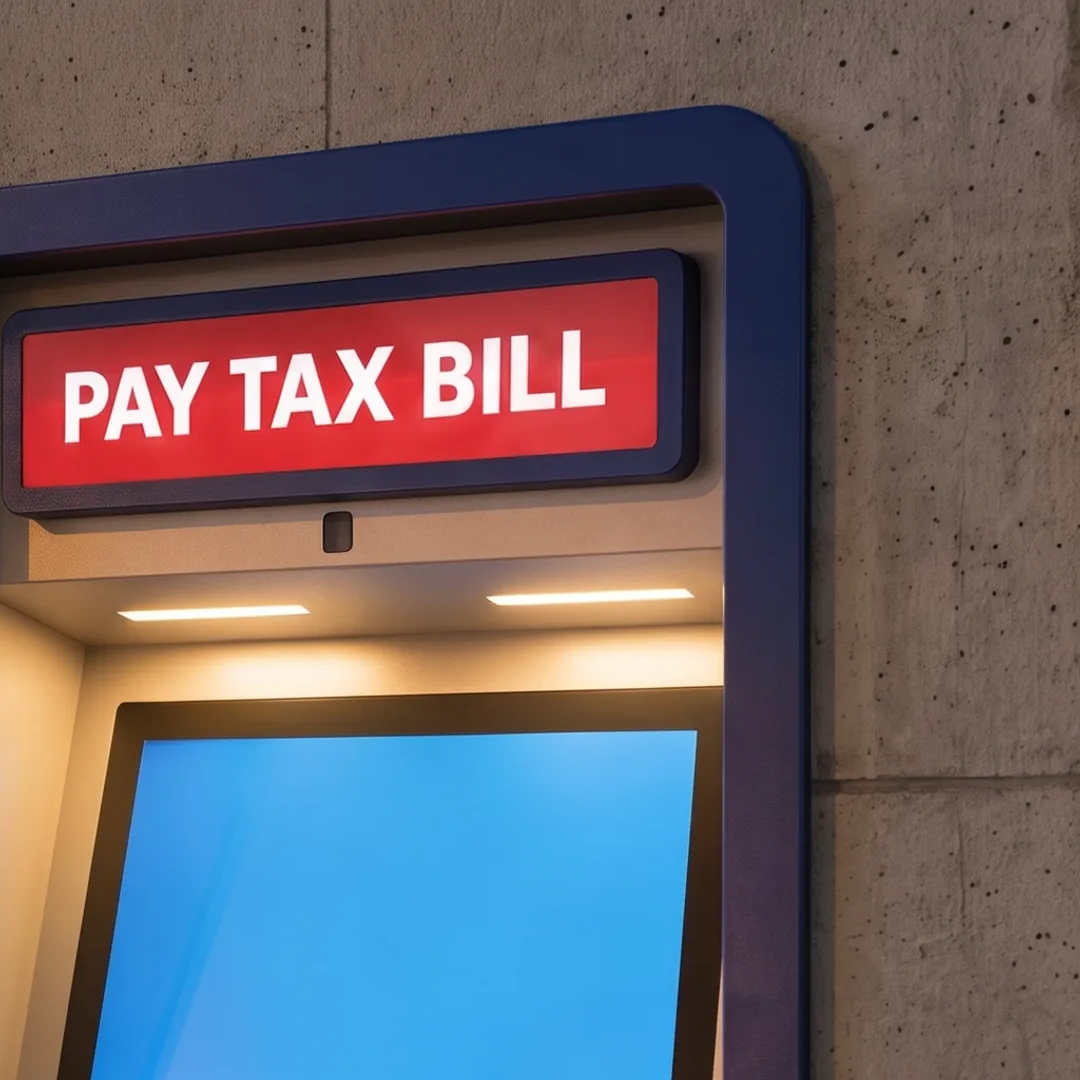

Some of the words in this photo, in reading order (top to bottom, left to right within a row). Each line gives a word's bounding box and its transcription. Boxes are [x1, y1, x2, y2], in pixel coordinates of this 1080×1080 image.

[64, 360, 210, 444] PAY
[229, 345, 395, 431] TAX
[423, 329, 606, 420] BILL
